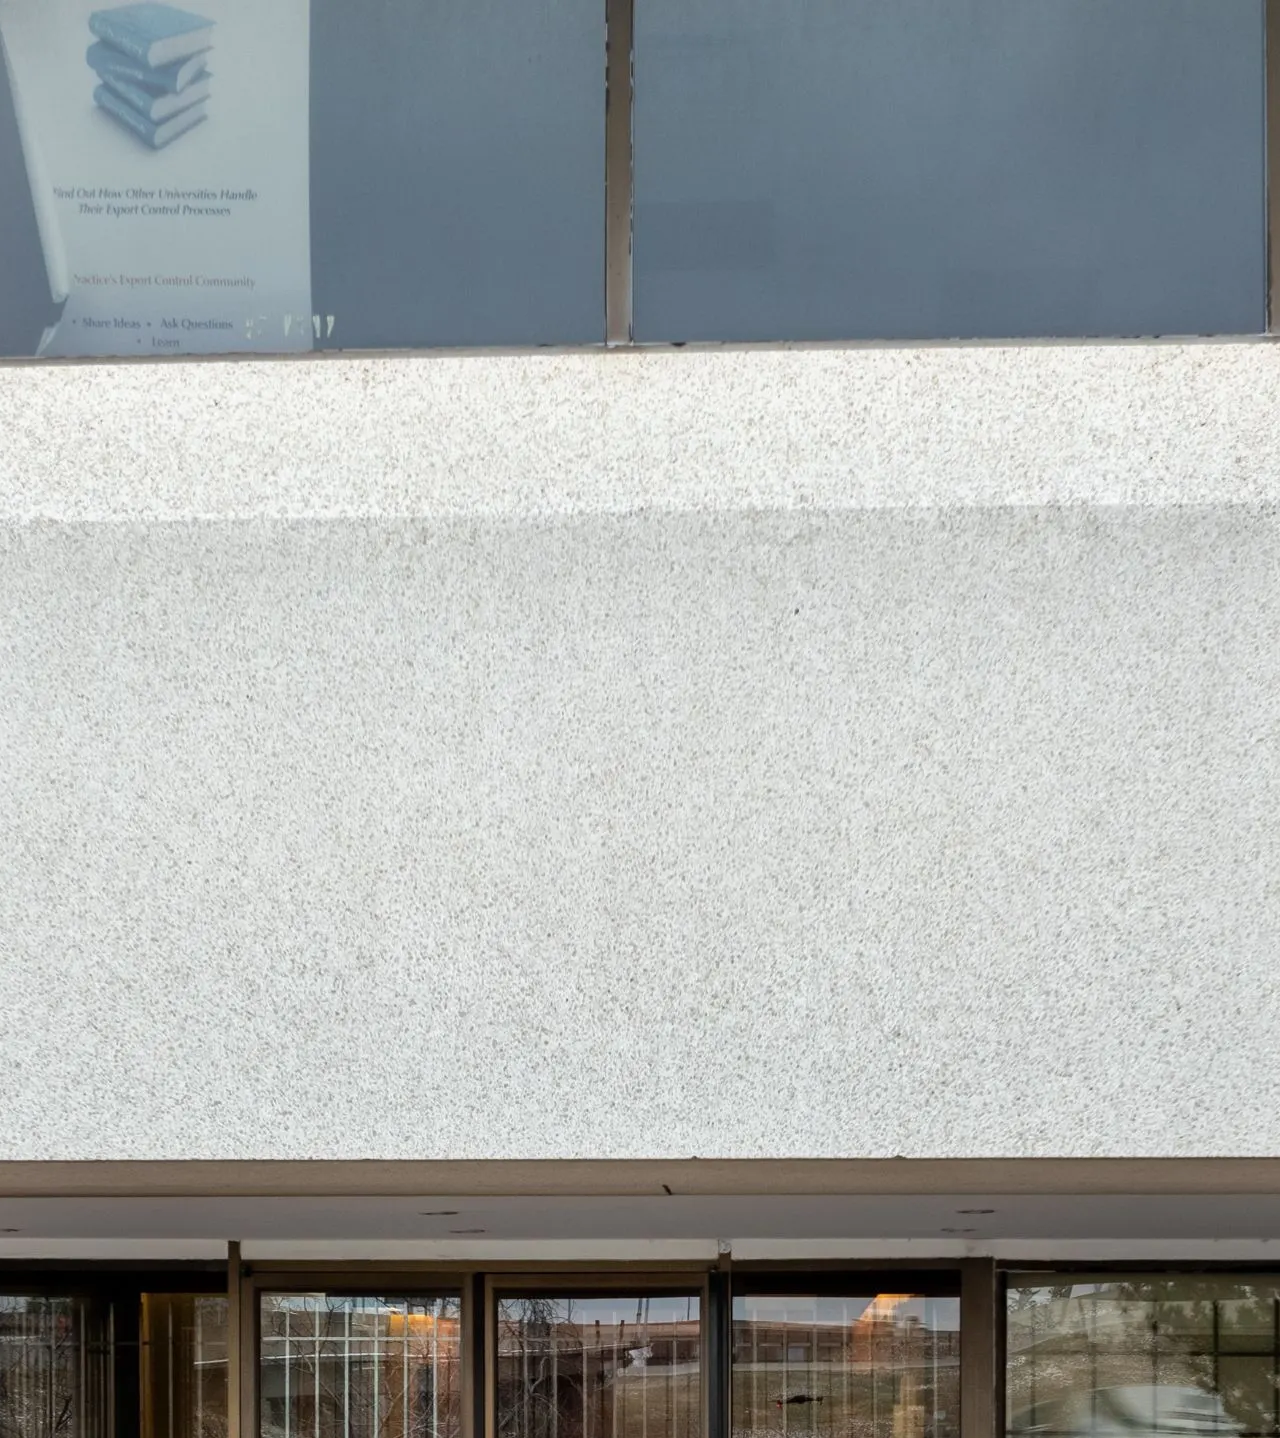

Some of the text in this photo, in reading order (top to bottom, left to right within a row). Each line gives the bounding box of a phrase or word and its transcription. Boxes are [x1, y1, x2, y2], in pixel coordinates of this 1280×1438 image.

[76, 187, 96, 200] Out
[98, 187, 122, 200] How
[125, 187, 155, 200] Other
[158, 187, 218, 201] Universities
[219, 188, 258, 201] Handle
[78, 203, 232, 219] Their Export Control Processes
[154, 275, 193, 287] Control
[194, 275, 256, 290] Community
[82, 316, 234, 331] Share Ideas Ask Questions
